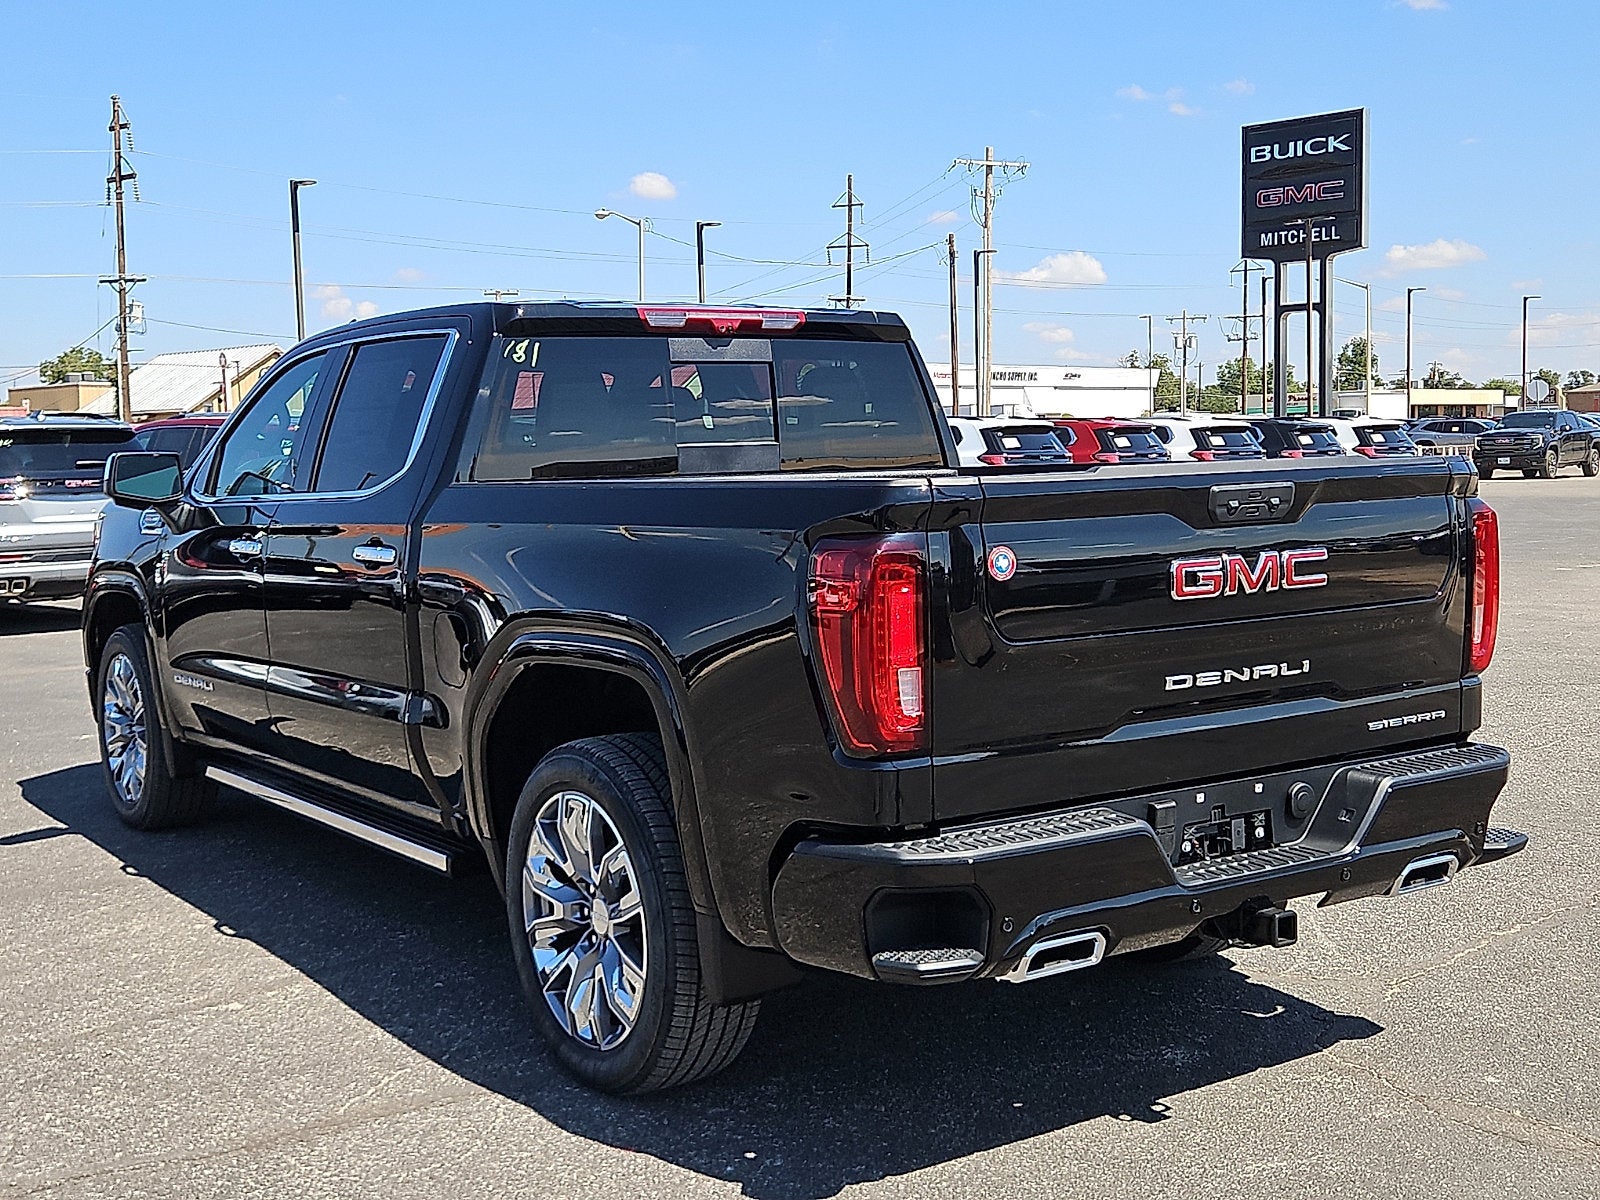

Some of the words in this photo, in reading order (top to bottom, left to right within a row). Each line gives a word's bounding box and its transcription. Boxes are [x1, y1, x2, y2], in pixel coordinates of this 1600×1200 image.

[1250, 133, 1352, 163] BUICK
[1256, 180, 1344, 207] GMC
[1260, 226, 1340, 246] MITCHELL
[503, 339, 540, 368] 181
[1170, 547, 1329, 600] GMC
[174, 675, 214, 691] DENALI
[1165, 659, 1310, 690] DENALI
[1367, 709, 1446, 731] SIERRA
